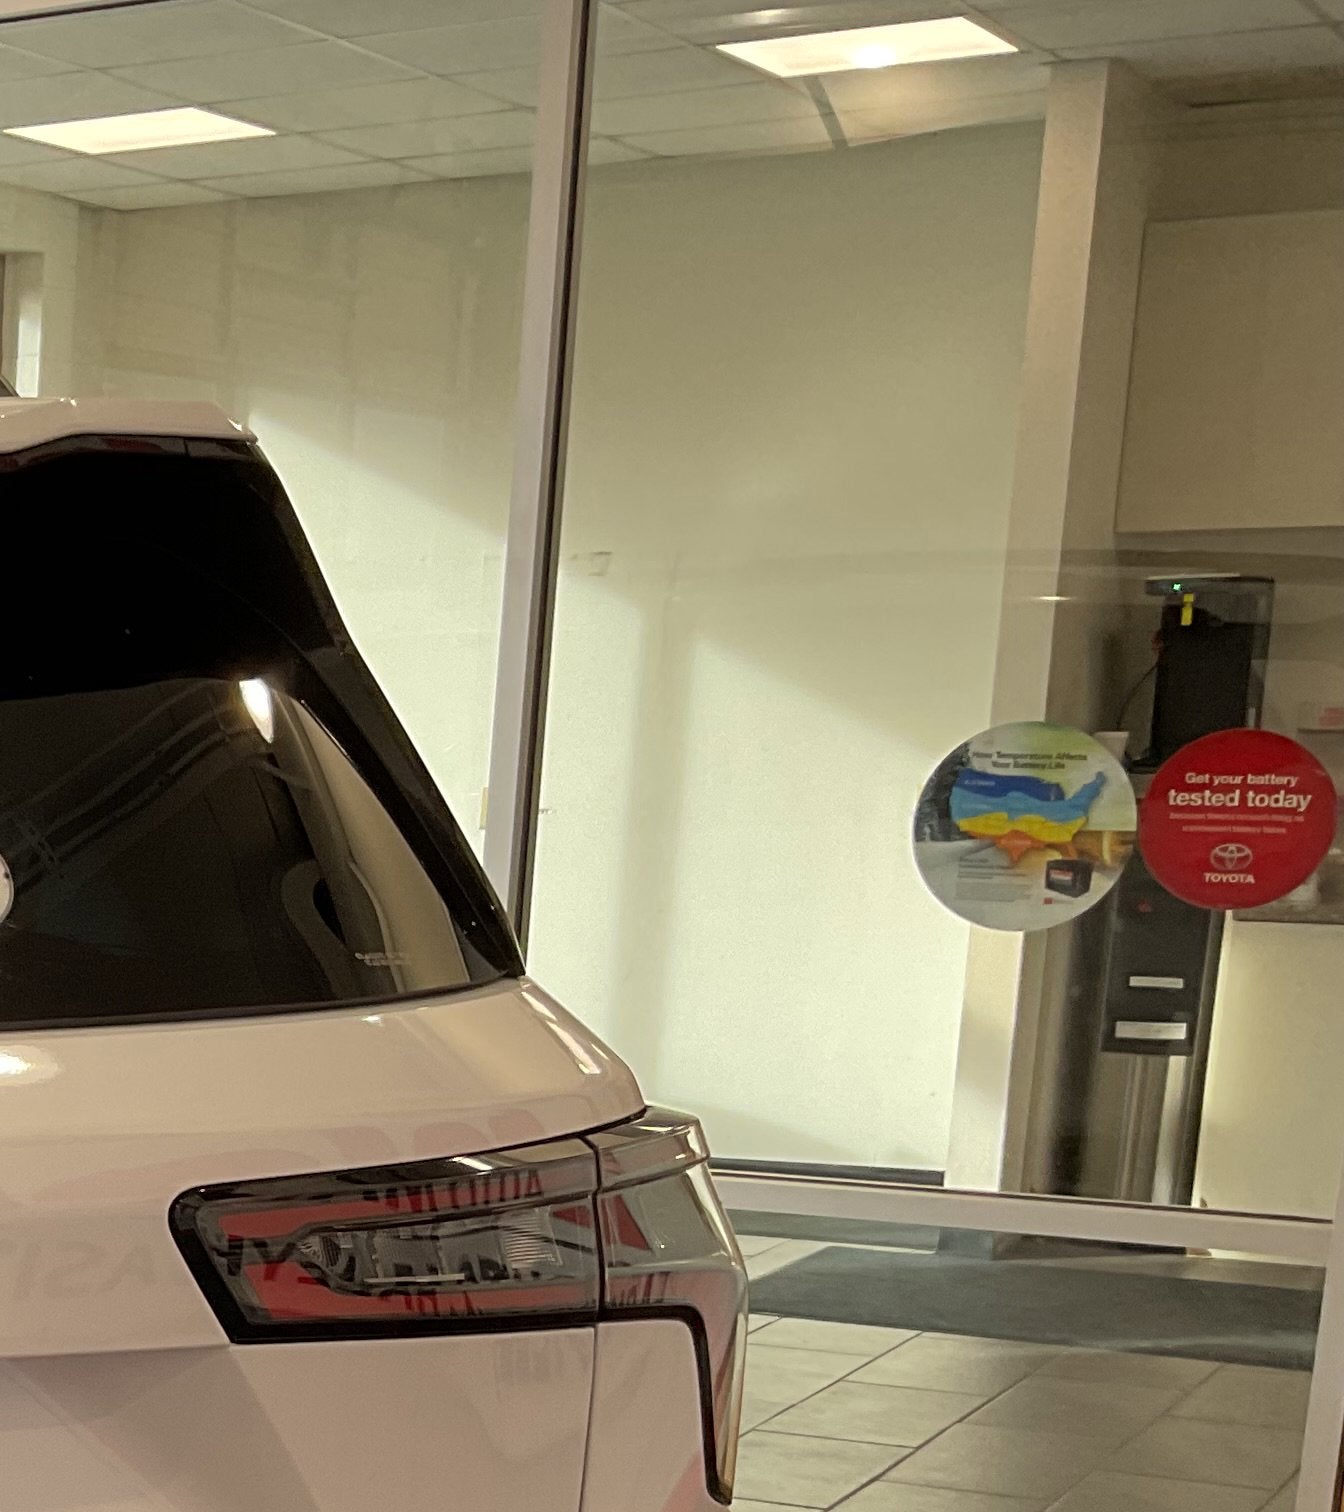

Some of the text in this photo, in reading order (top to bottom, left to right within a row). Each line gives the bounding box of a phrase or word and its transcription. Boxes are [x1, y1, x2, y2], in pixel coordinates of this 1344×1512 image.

[1185, 772, 1298, 788] Get your battery
[1168, 788, 1312, 812] tested today
[1204, 872, 1255, 884] TOYOTA
